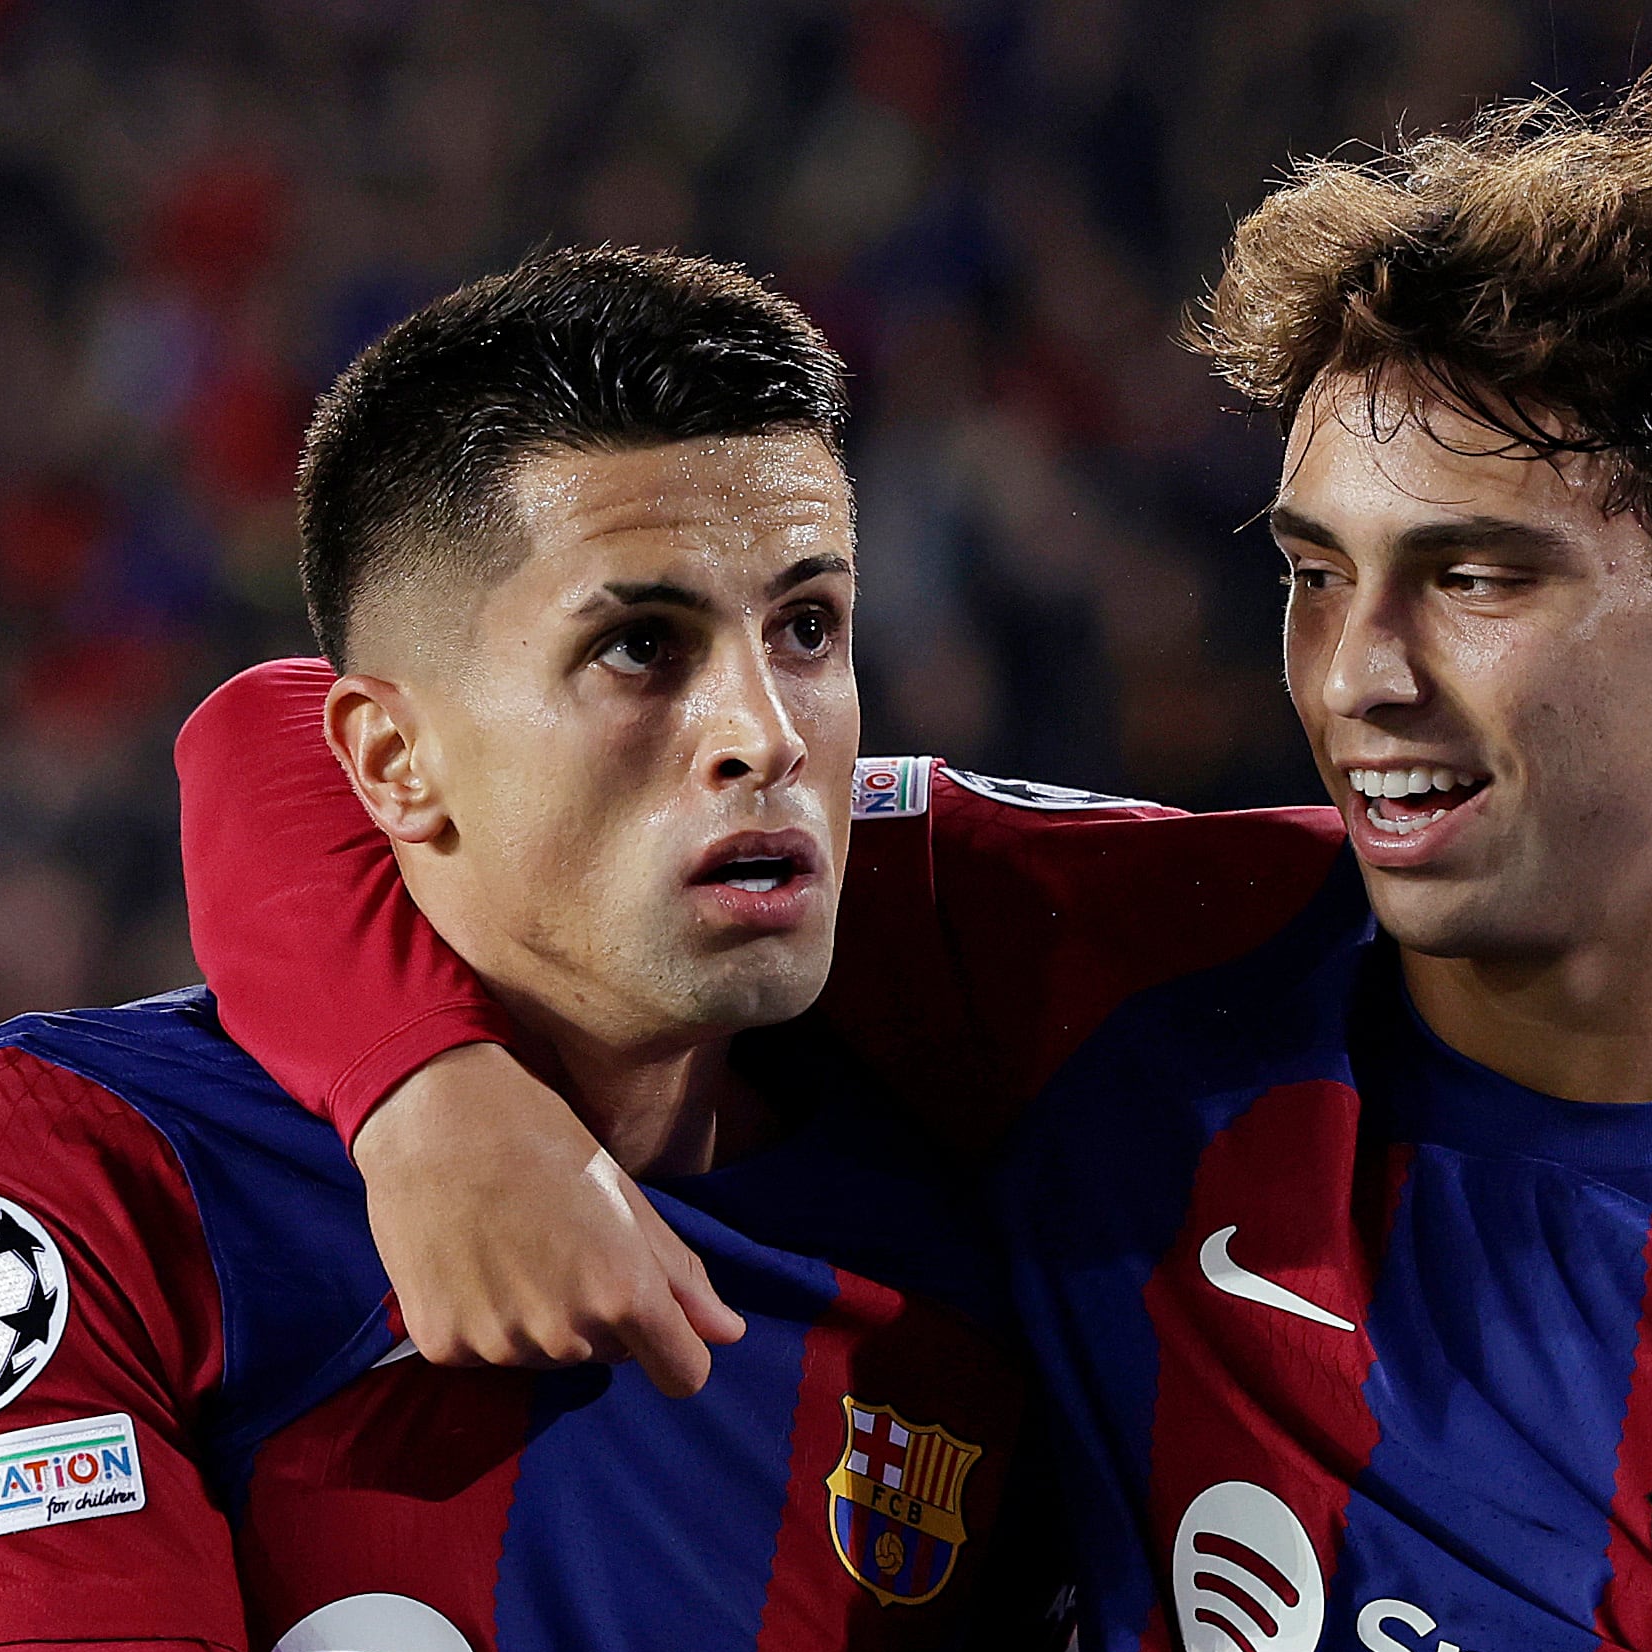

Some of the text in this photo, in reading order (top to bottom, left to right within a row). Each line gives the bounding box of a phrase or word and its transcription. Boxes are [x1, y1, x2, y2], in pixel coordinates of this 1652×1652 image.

[46, 1487, 138, 1522] for children
[871, 1485, 923, 1525] FCB
